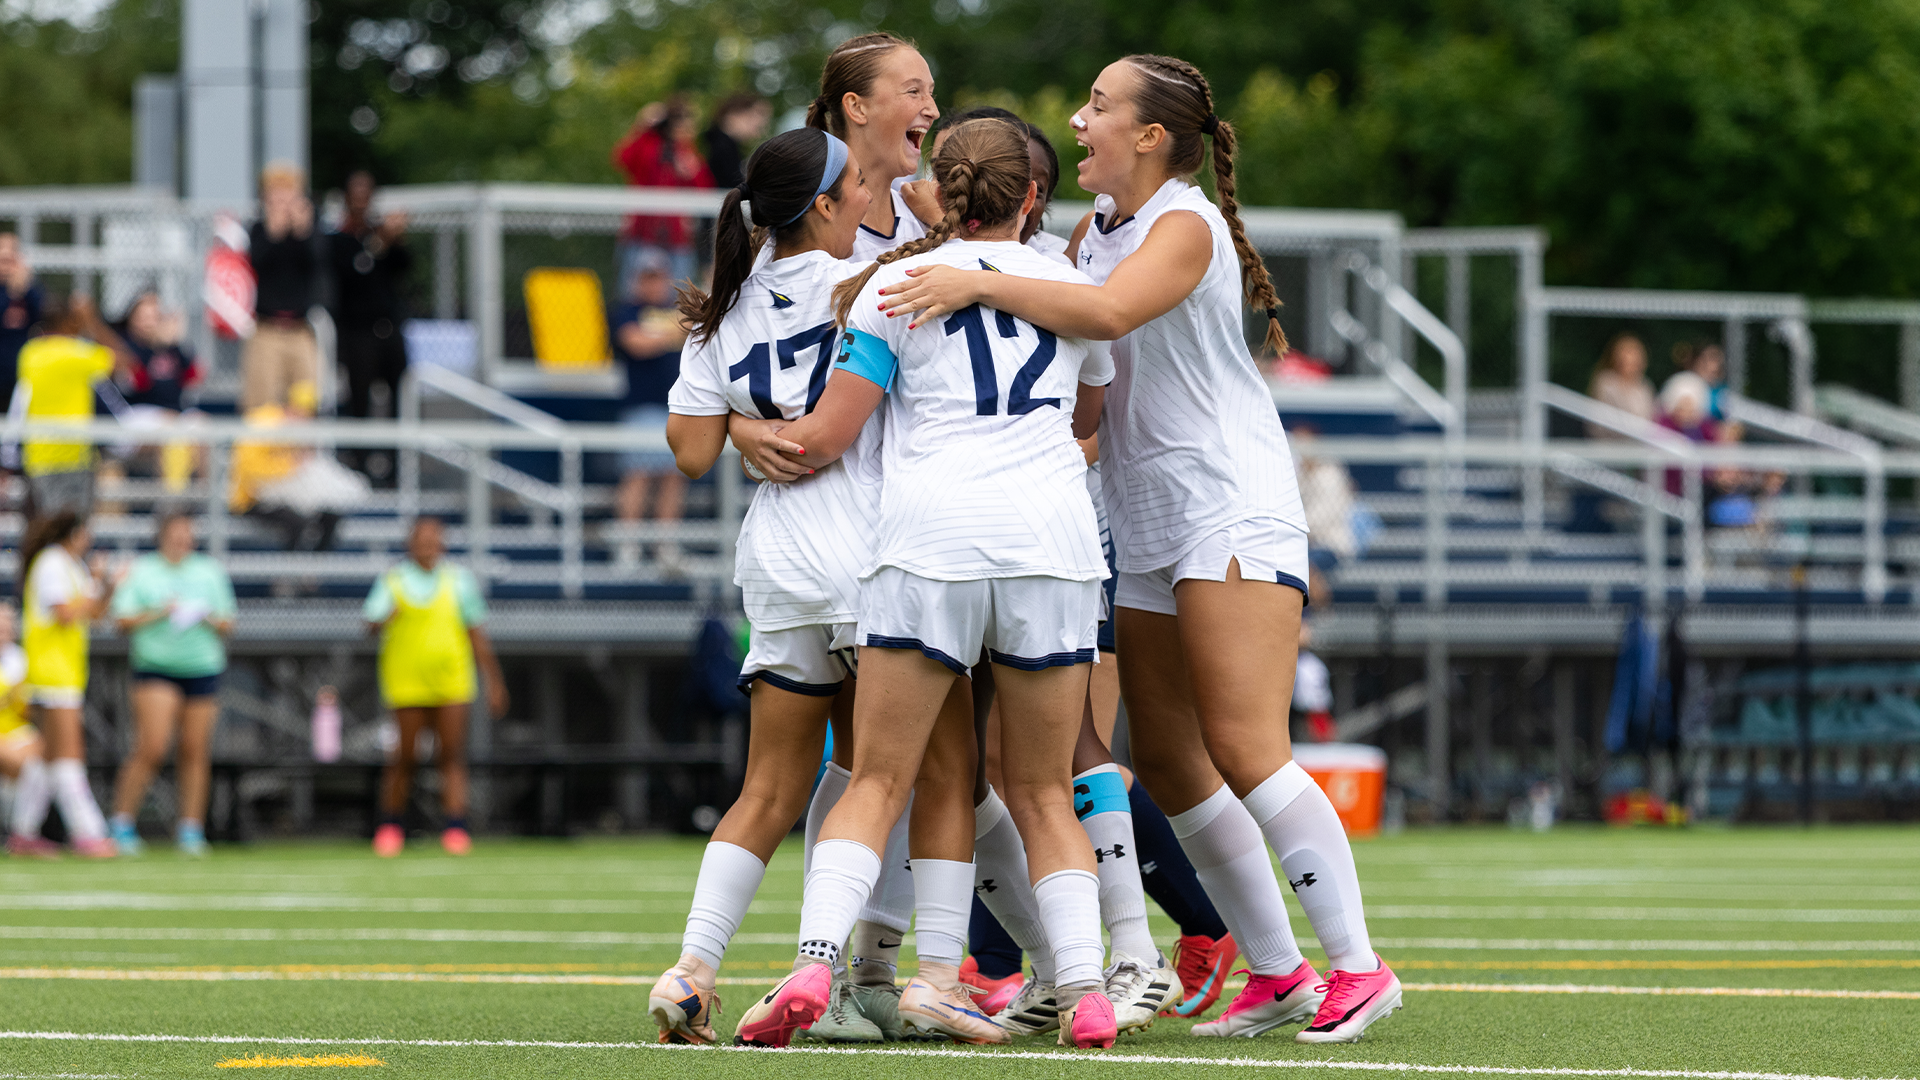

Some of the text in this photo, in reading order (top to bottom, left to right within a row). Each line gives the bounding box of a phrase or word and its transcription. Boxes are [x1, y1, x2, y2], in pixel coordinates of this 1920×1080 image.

[729, 319, 838, 420] 17
[837, 332, 855, 363] C
[943, 302, 1060, 415] 12
[1074, 784, 1094, 819] C
